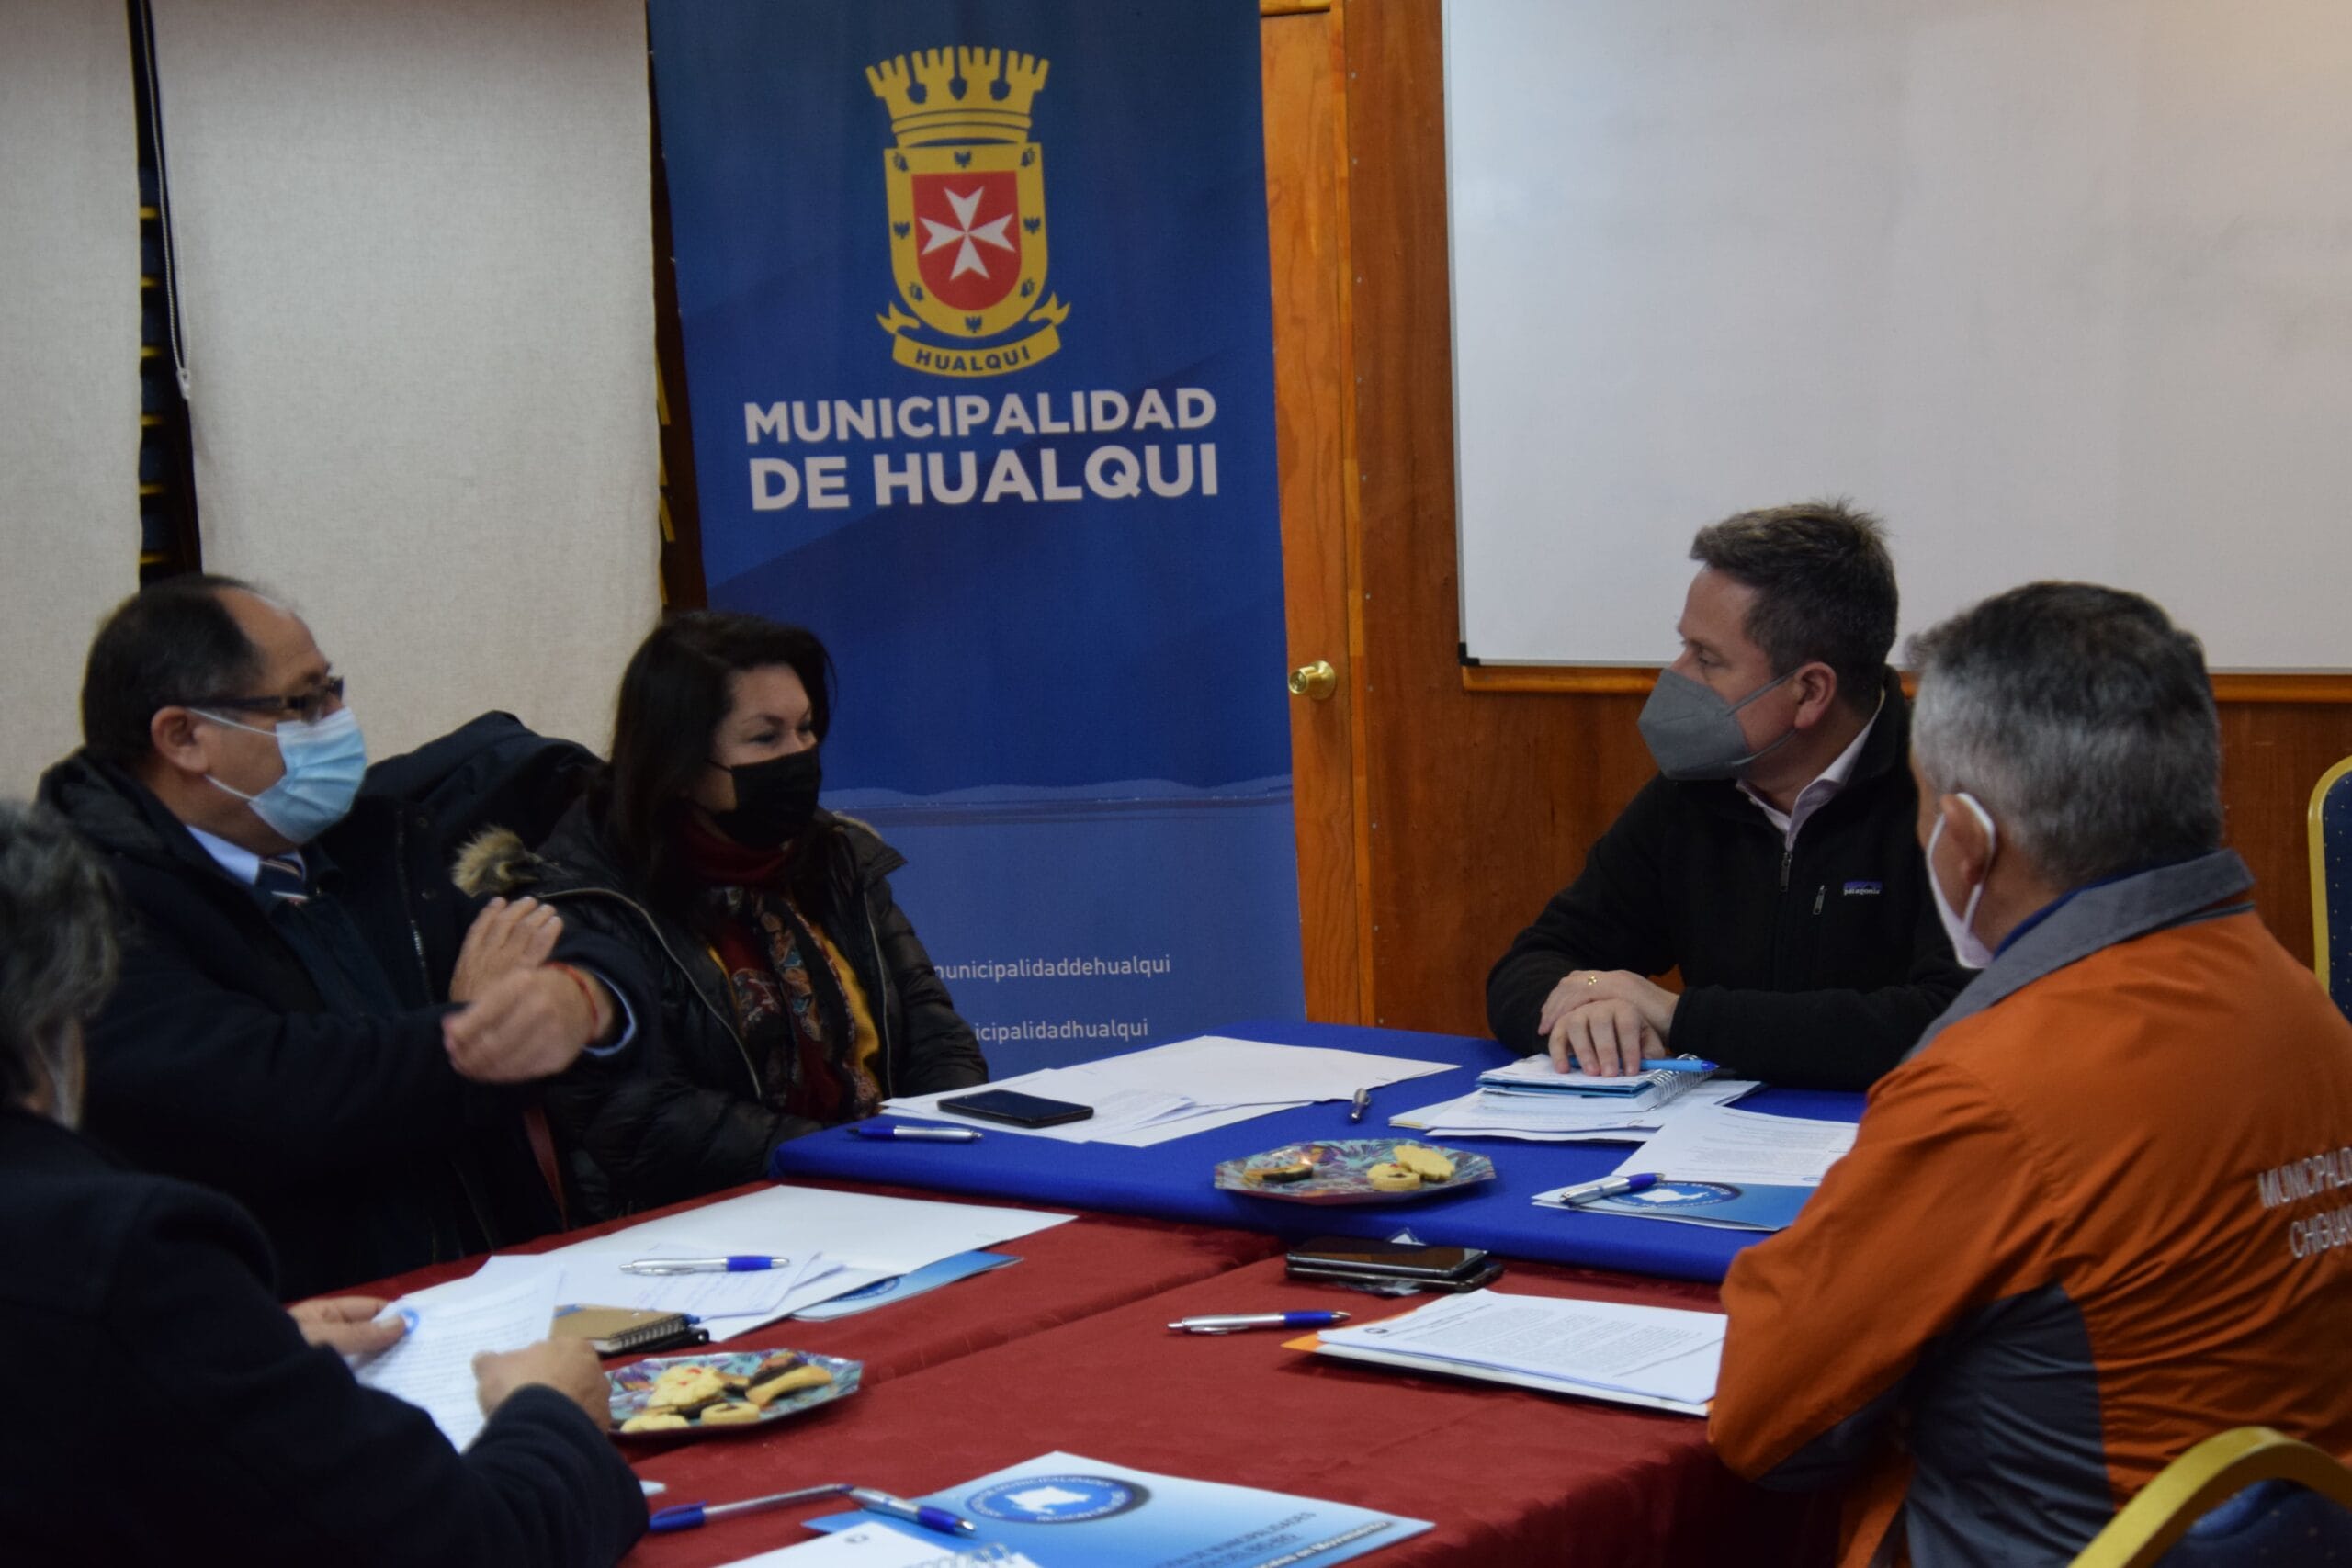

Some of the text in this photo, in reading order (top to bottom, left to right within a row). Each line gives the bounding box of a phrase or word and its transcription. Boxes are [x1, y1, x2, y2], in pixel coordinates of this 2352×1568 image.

[915, 345, 1031, 371] HUALQUI
[744, 388, 1216, 444] MUNICIPALIDAD
[749, 443, 1218, 511] DE HUALQUI
